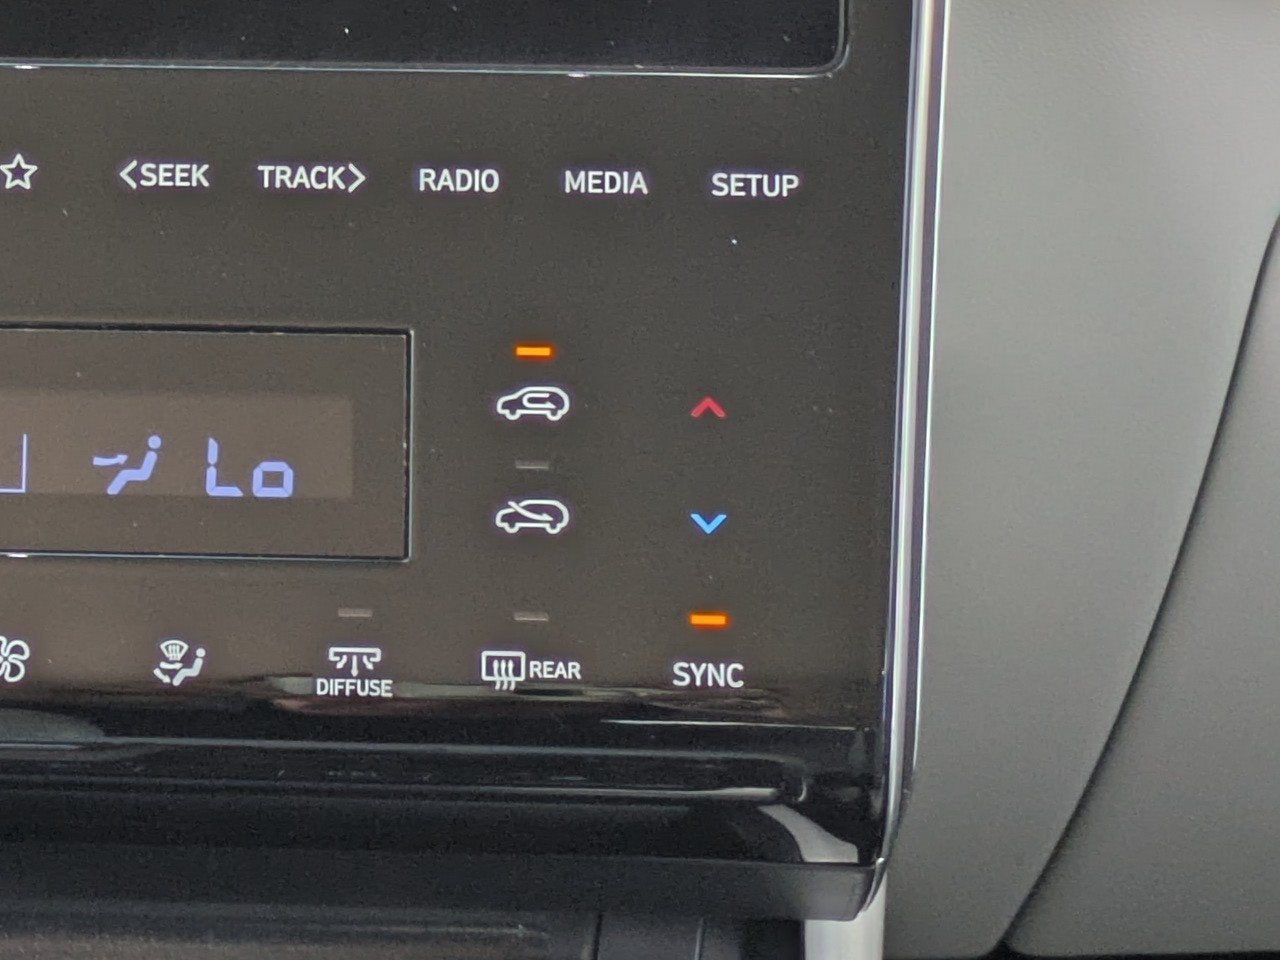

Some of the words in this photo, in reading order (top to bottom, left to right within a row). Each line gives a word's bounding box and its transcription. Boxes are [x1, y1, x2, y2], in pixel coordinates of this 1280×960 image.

[418, 168, 500, 193] RADIO
[564, 170, 649, 196] MEDIA
[711, 172, 800, 198] SETUP
[528, 661, 581, 680] REAR
[672, 662, 745, 689] SYNC
[315, 678, 394, 698] DIFFUSE
